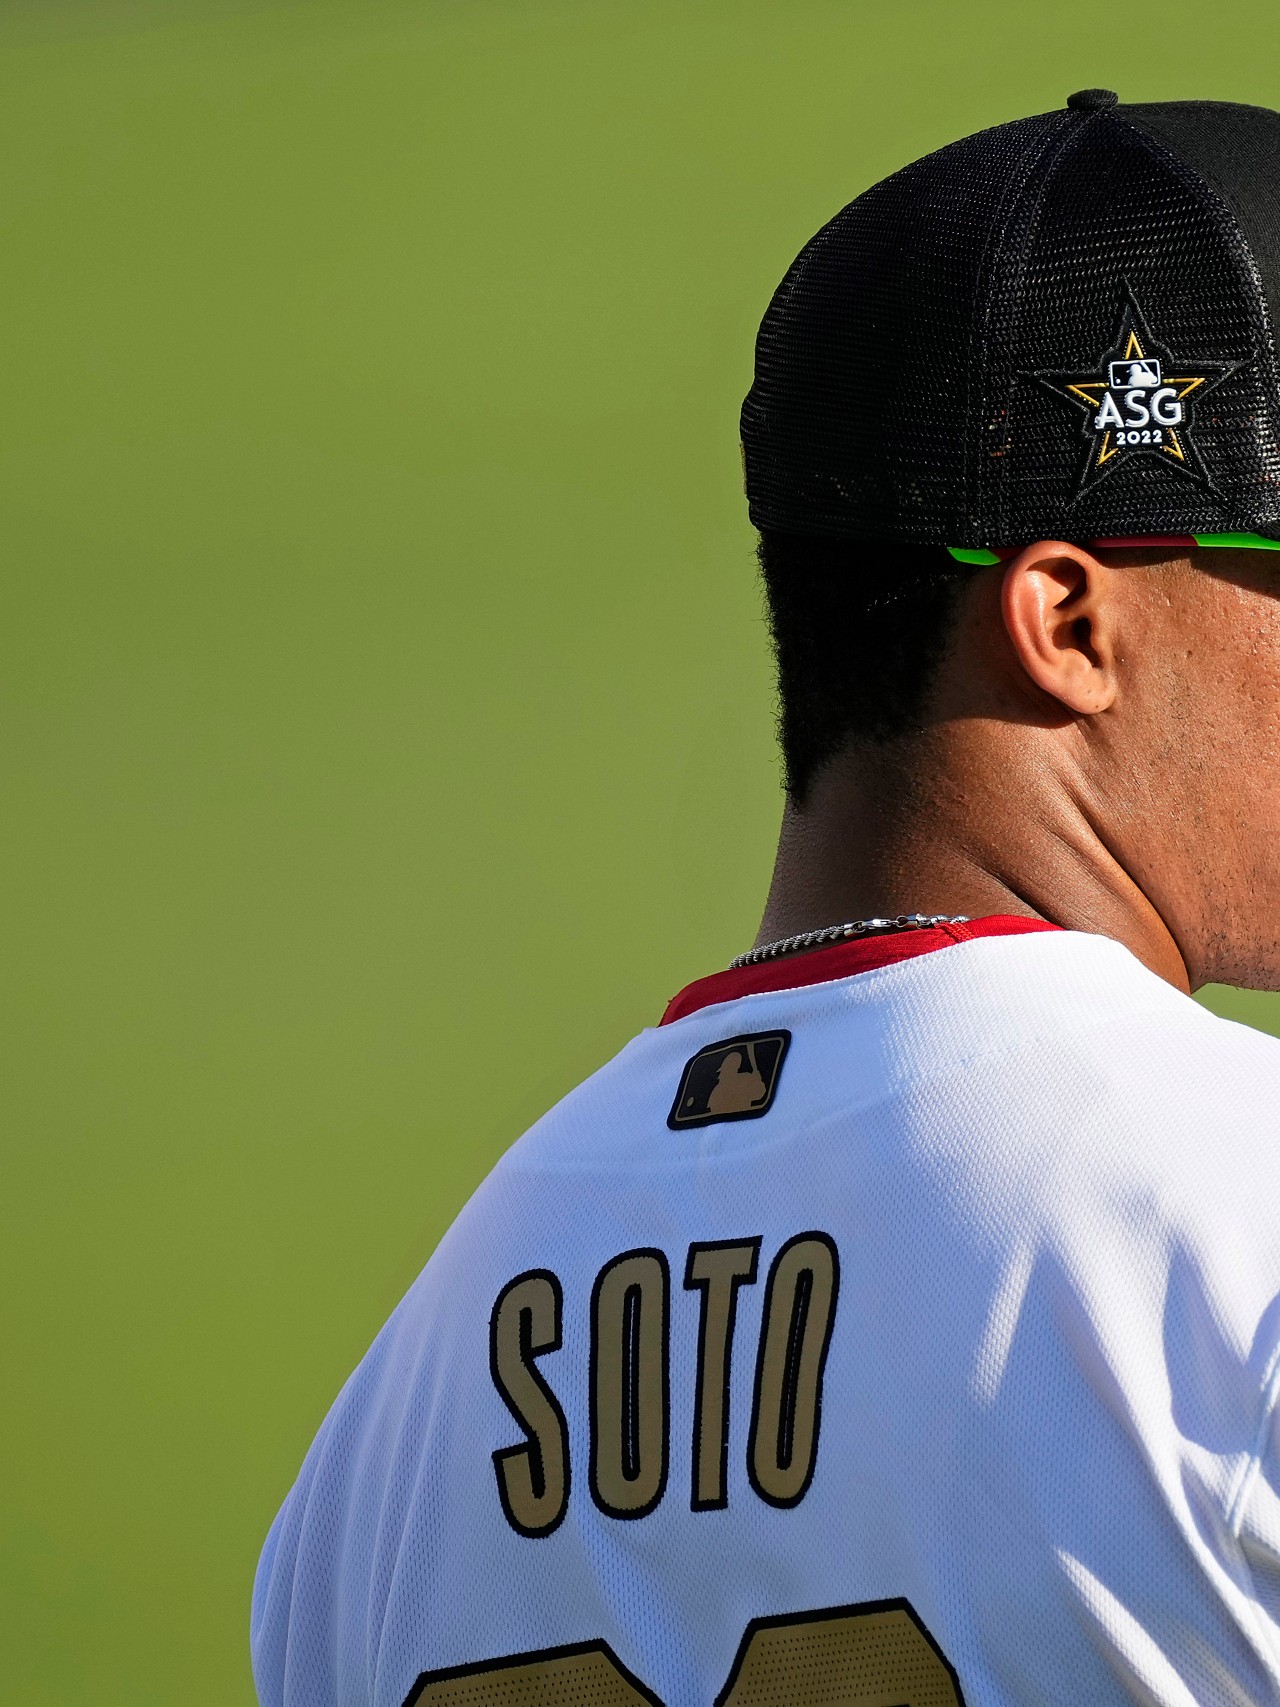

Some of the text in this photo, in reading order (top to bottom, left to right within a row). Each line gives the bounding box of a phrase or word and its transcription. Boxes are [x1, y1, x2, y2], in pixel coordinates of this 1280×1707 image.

[1094, 388, 1183, 430] ASG
[1116, 429, 1163, 445] 2022
[489, 1230, 841, 1539] SOTO
